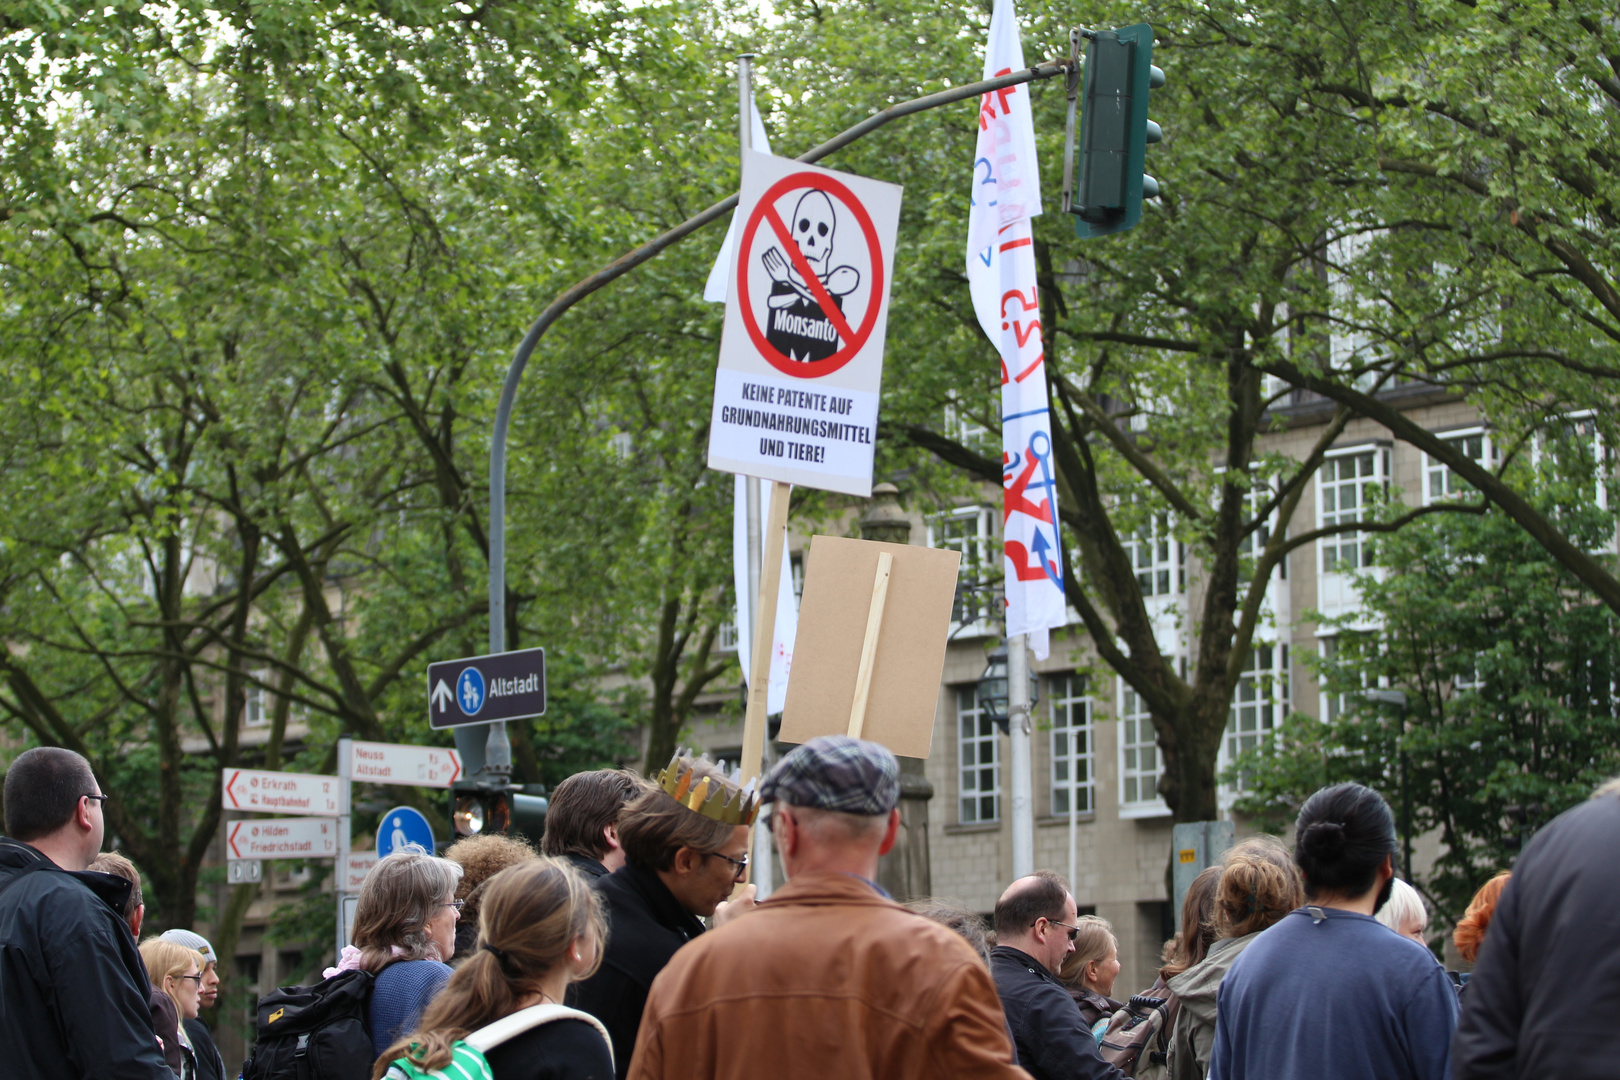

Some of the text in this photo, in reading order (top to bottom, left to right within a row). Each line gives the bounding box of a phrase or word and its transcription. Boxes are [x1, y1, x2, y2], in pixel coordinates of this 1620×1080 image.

[774, 309, 838, 343] Monsanto
[742, 382, 853, 416] KEINE PATENTE AUF
[721, 405, 871, 444] GRUNDNAHRUNGSMITTEL
[759, 437, 825, 463] UND TIERE!
[489, 673, 539, 698] Altstadt
[356, 748, 384, 760] Neuss
[356, 764, 392, 777] Altstadt
[261, 777, 297, 791] Erkrath
[261, 794, 310, 808] Hauptbahnhof
[262, 825, 289, 836] Hilden
[251, 841, 312, 853] Friedrichstadt
